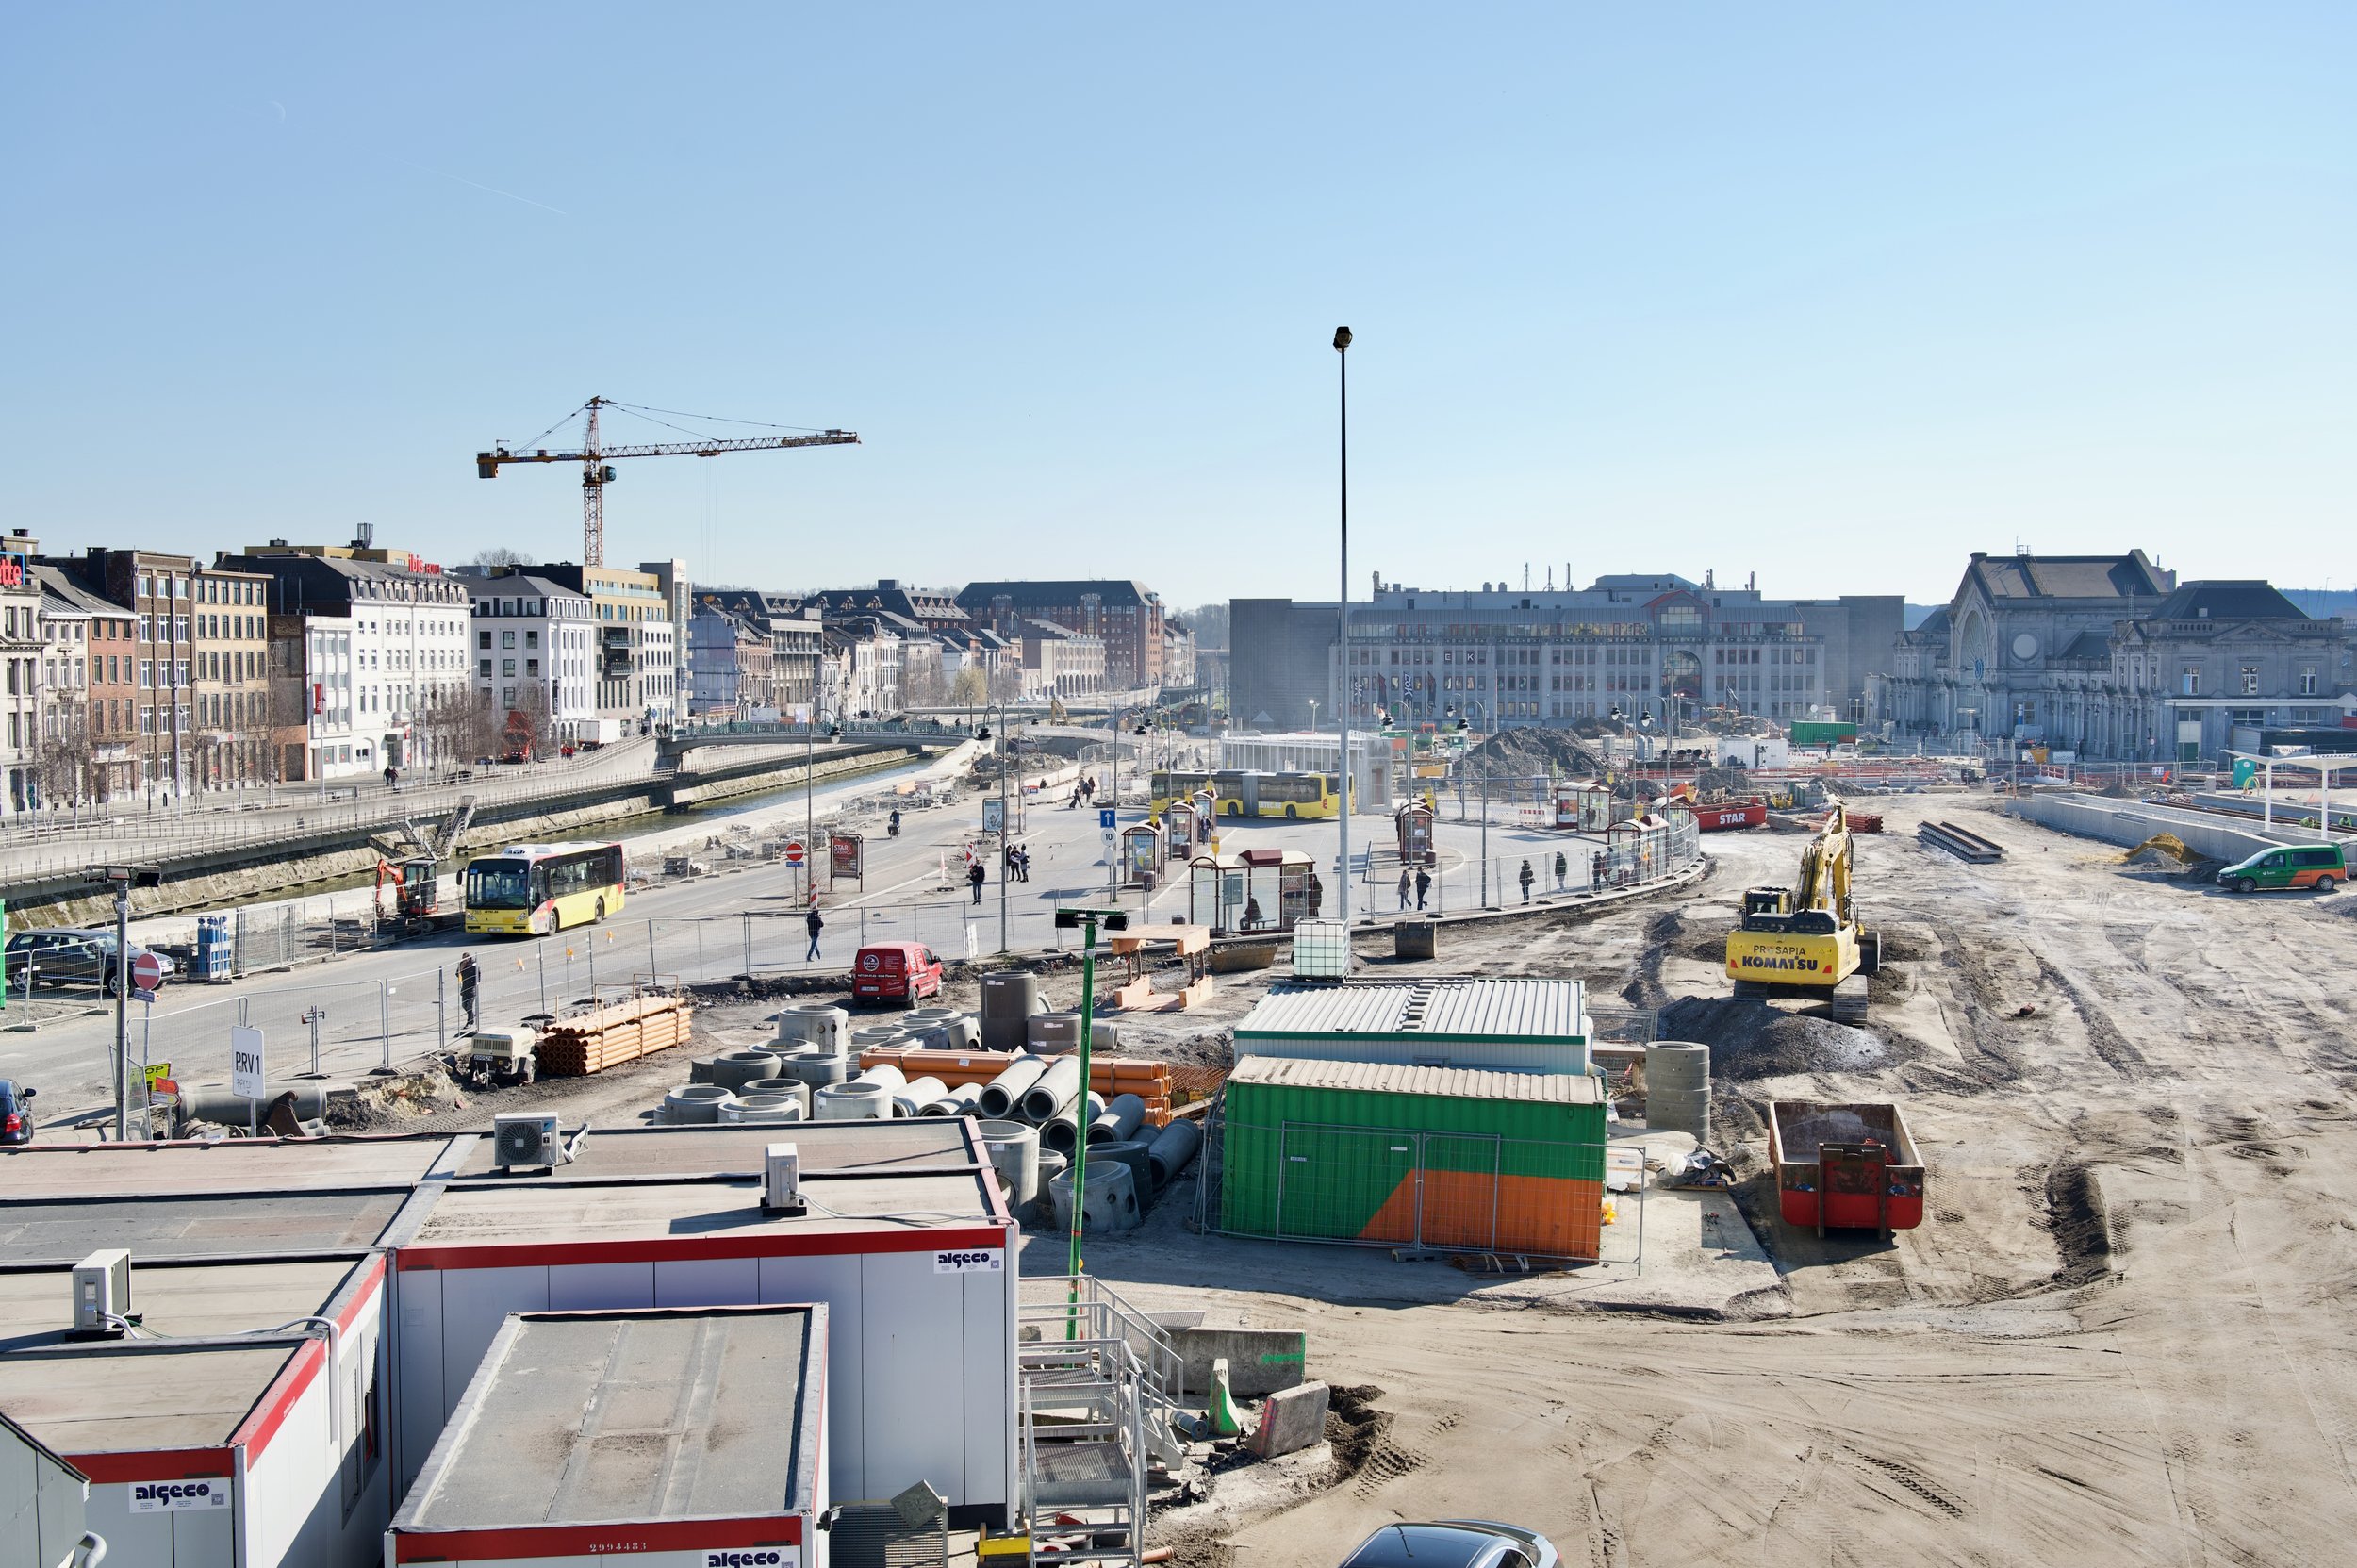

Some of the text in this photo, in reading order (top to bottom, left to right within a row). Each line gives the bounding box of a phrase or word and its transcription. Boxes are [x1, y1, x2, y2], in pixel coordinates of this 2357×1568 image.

[408, 553, 423, 573] ibis
[0, 558, 22, 586] tte
[1719, 812, 1746, 825] STAR
[1105, 833, 1113, 841] 10
[1741, 955, 1818, 971] KOMATSU
[235, 1051, 255, 1074] PRV
[938, 1252, 990, 1269] algeco
[135, 1483, 210, 1507] algeco
[708, 1552, 781, 1568] algeco
